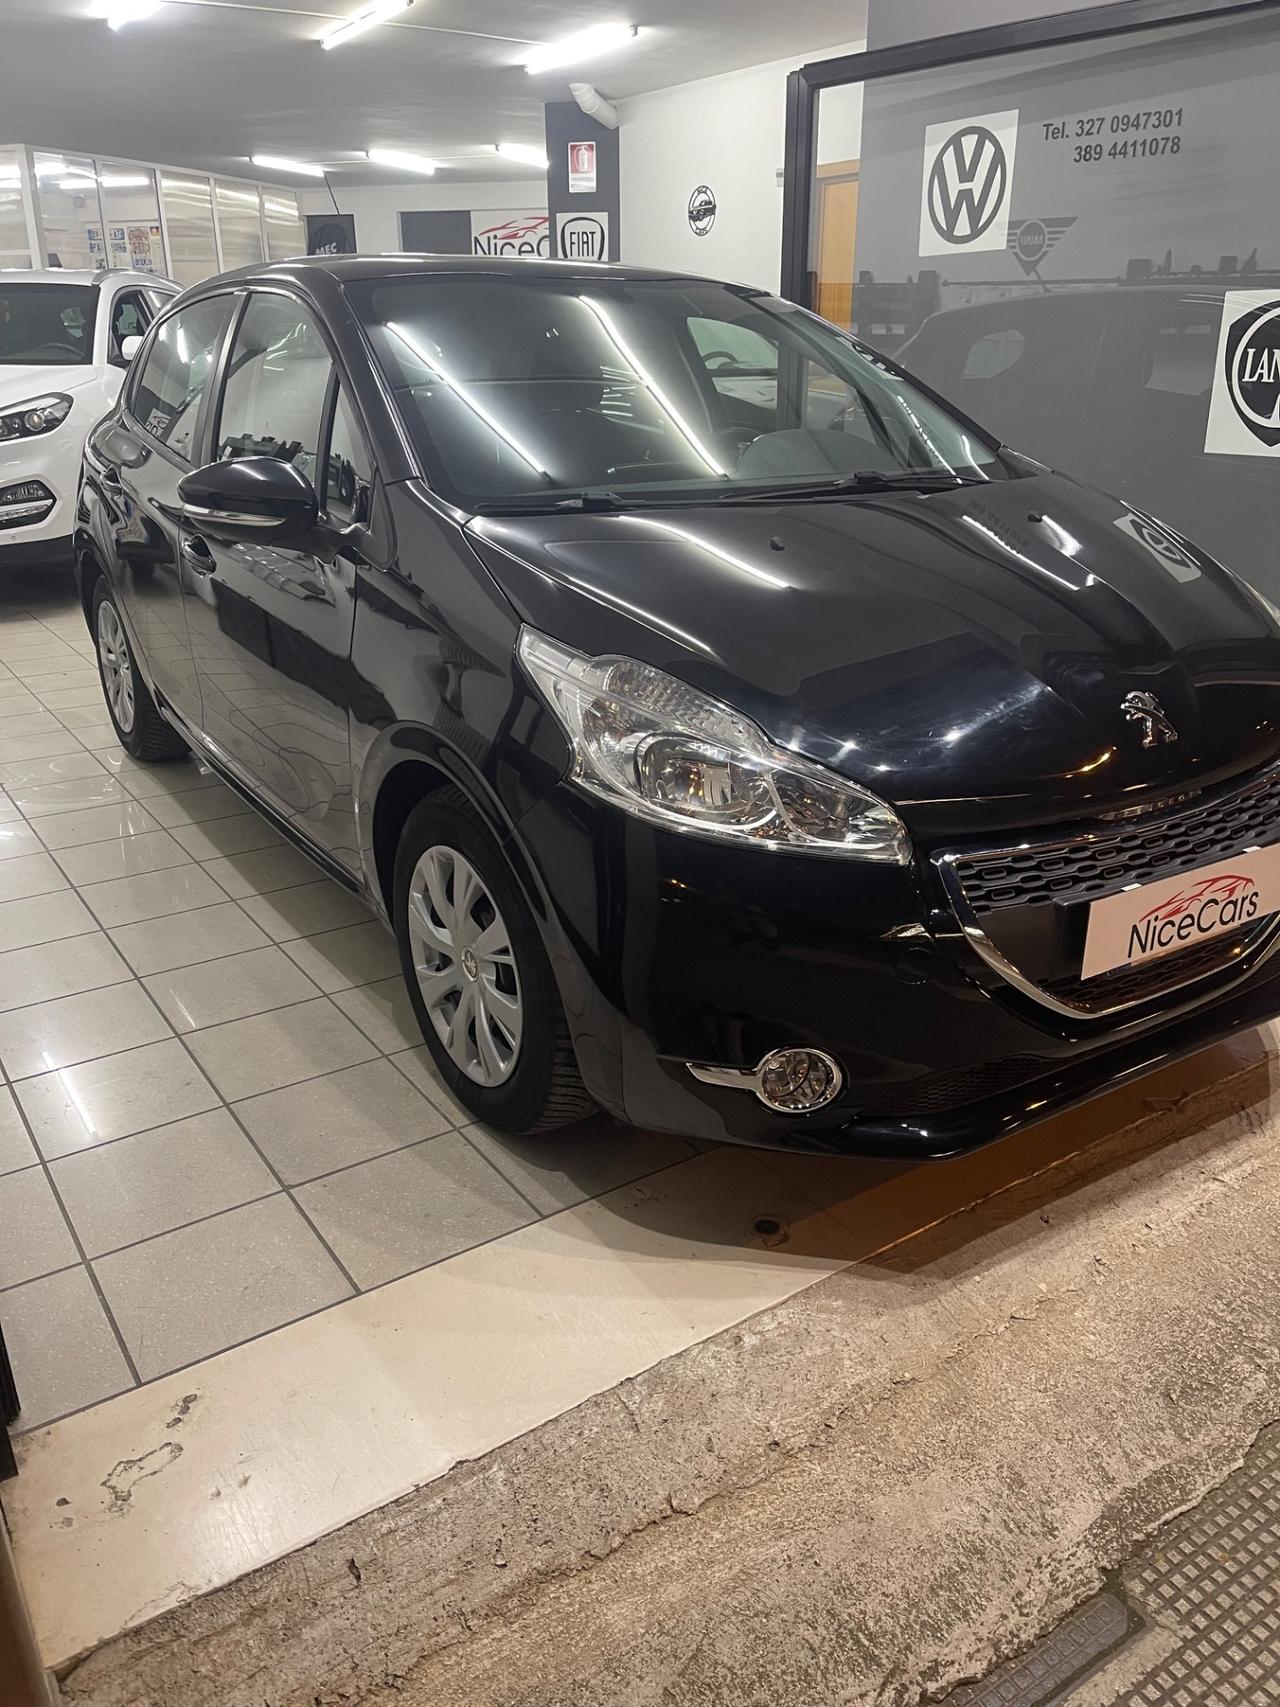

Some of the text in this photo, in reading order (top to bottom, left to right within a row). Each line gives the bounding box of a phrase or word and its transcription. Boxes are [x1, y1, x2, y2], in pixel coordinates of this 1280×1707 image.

[1042, 108, 1183, 141] Tel. 327 0947301
[1073, 136, 1181, 163] 389 4411078
[569, 231, 597, 258] FIAT
[1127, 890, 1260, 958] NiceCars
